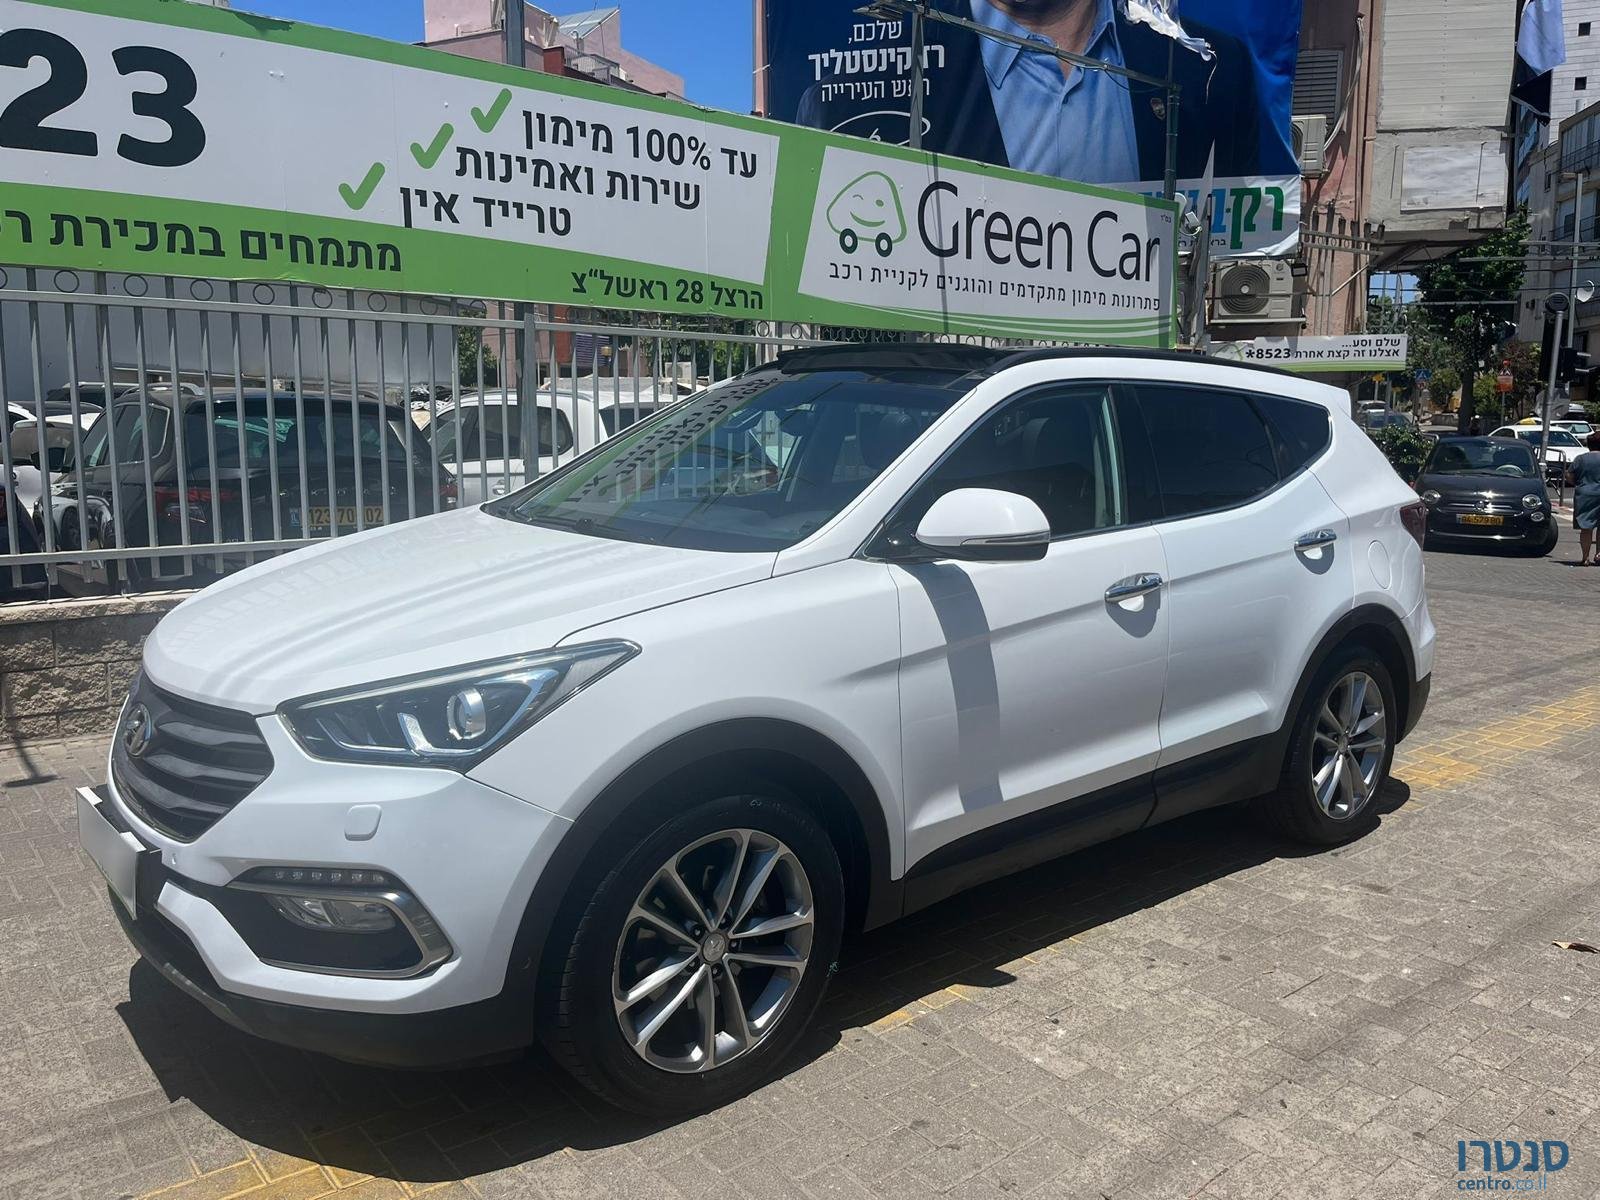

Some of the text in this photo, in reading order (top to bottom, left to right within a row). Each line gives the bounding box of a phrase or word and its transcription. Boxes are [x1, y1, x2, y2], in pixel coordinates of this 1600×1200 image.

[848, 20, 902, 44] שלכם,
[822, 80, 885, 102] העירייה
[523, 110, 757, 178] עד 100% מימון
[456, 146, 700, 210] שירות ואמינות
[400, 187, 571, 236] טרייד אין
[50, 213, 226, 258] במכירת
[917, 181, 1160, 282] Green Car
[240, 230, 401, 272] מתמחים
[676, 279, 704, 303] 28
[710, 281, 763, 309] הרצל
[829, 262, 1160, 311] פתרונות מימון מתקדמים והוגנים לקניית רכב
[1295, 349, 1323, 358] אחרת
[1327, 350, 1349, 360] קצת
[1353, 349, 1365, 357] זה
[1369, 348, 1399, 357] אצלנו
[1376, 338, 1400, 347] שלם
